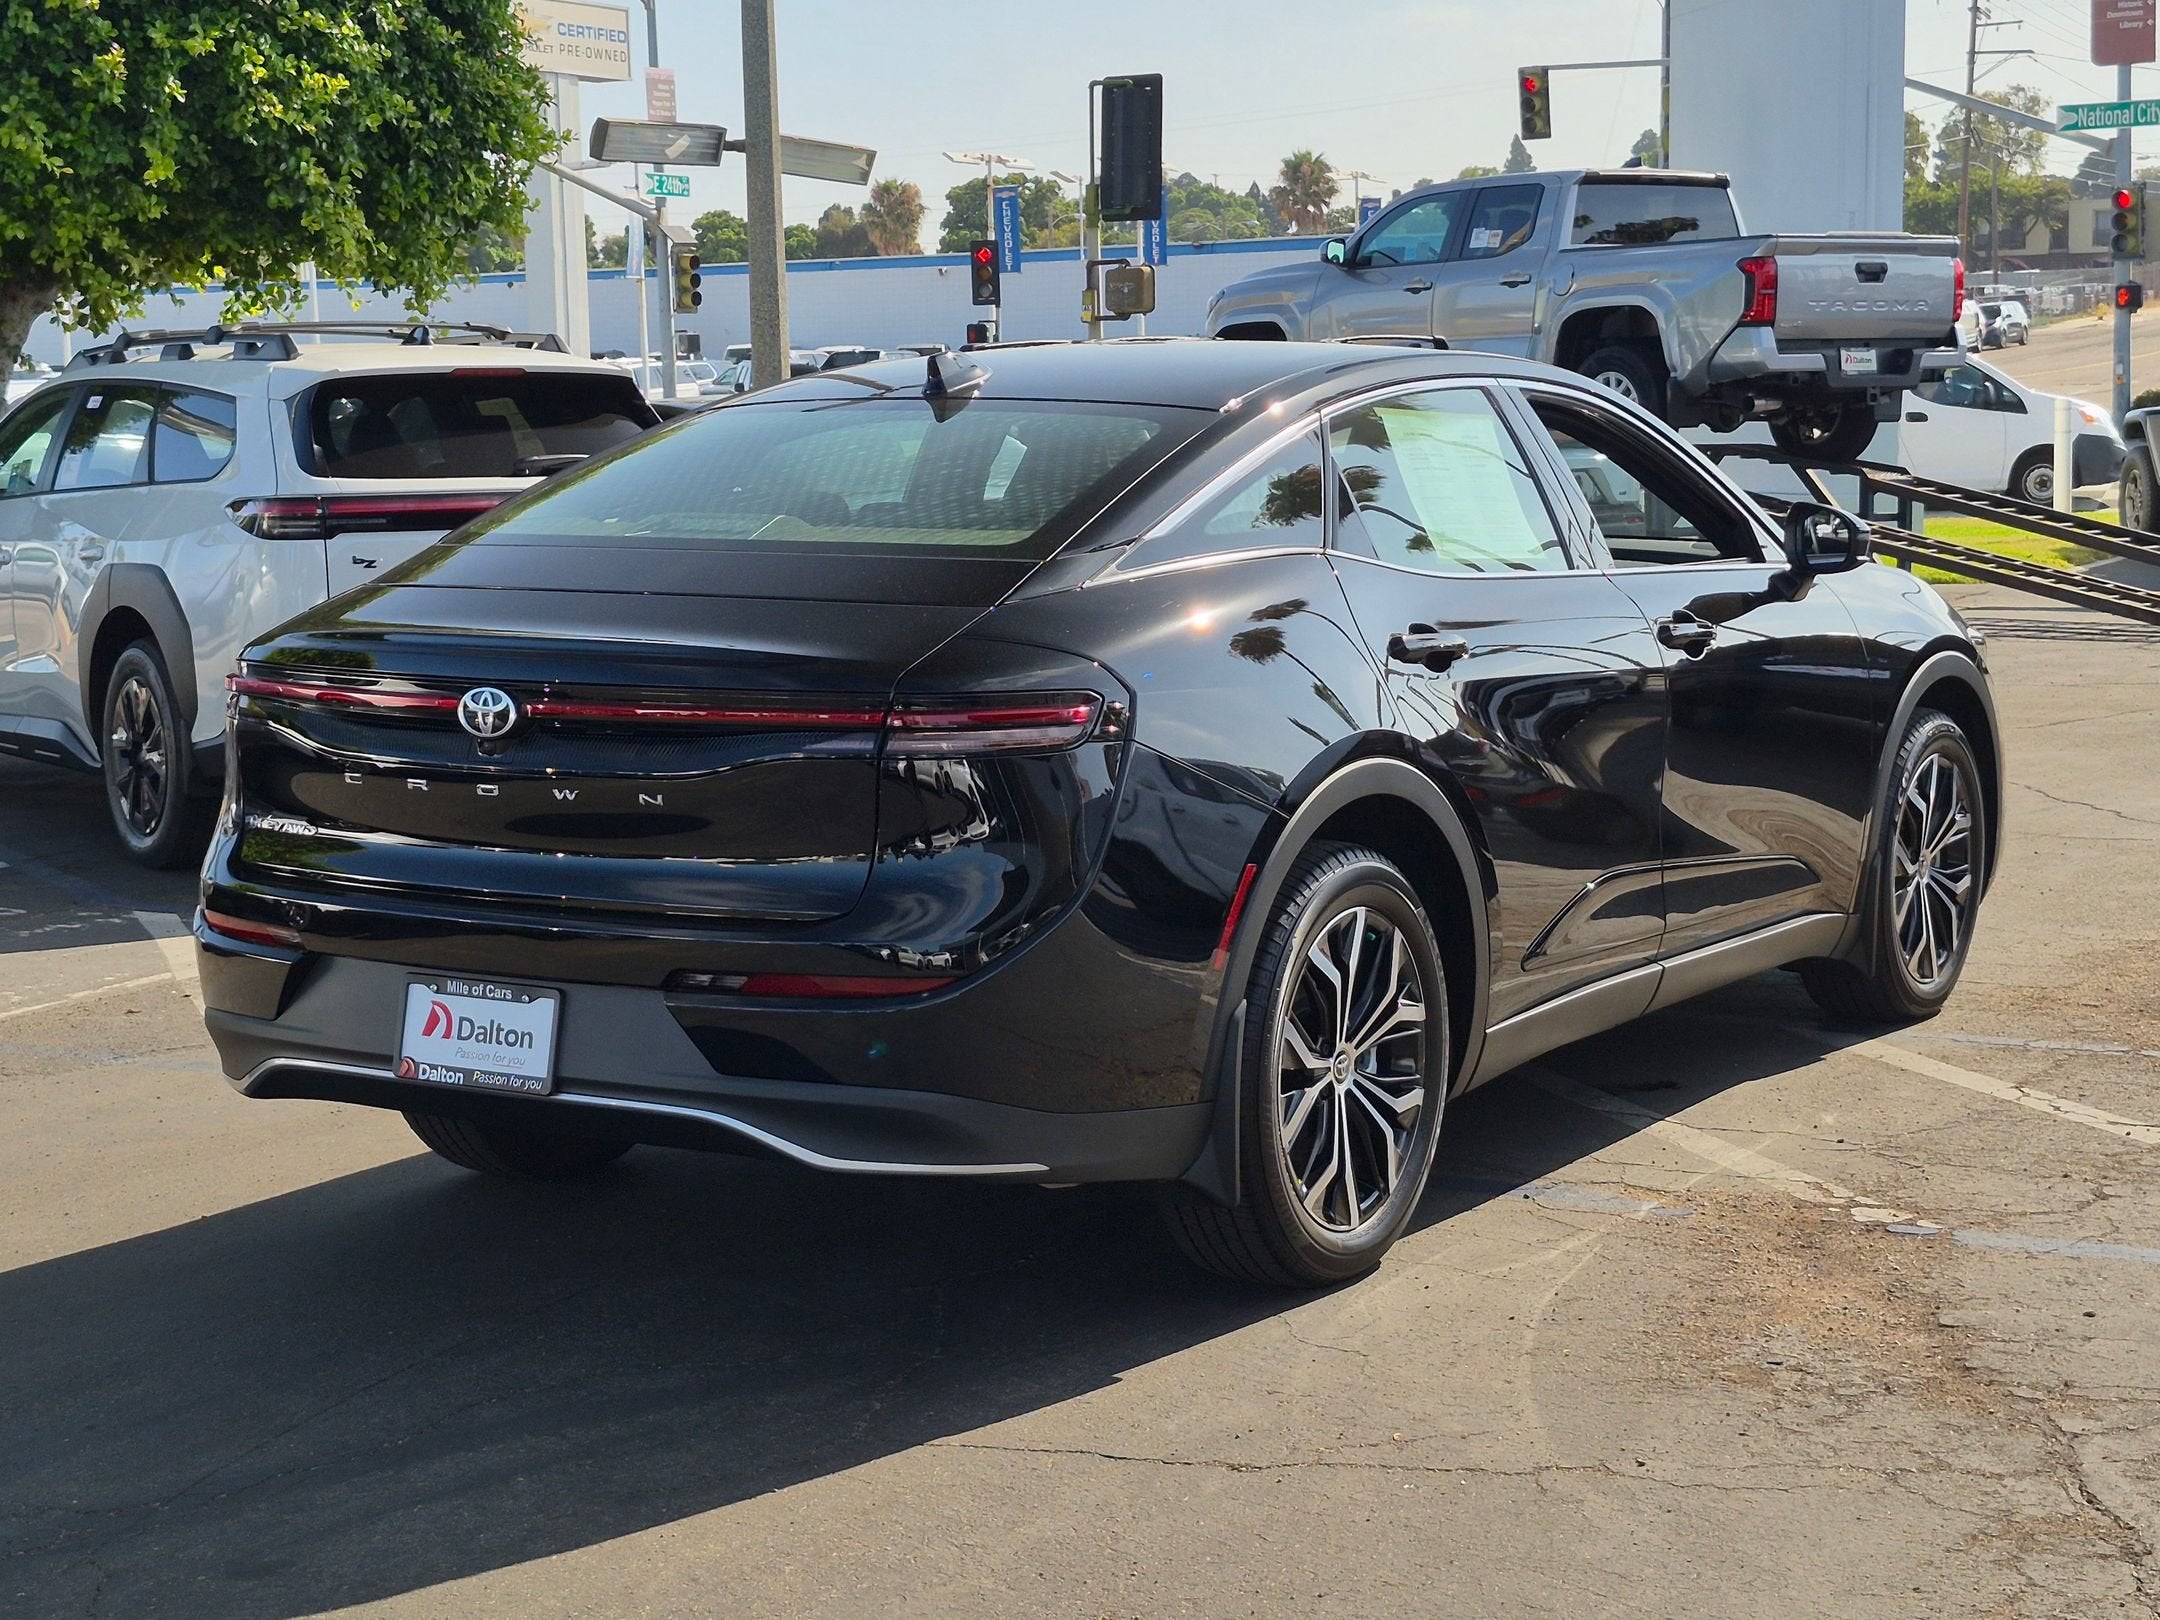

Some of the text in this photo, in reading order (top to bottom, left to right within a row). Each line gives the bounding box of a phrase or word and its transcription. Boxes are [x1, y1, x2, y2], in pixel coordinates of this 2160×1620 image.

[557, 22, 627, 44] CERTIFIED
[559, 43, 627, 62] PRE-OWNED
[2078, 104, 2135, 128] National
[654, 175, 661, 192] E
[662, 176, 682, 194] 24th
[1002, 201, 1013, 271] CHEVROLET
[1151, 220, 1160, 264] VROLET
[1808, 299, 1929, 312] TACOMA
[344, 771, 664, 806] CROWN
[447, 980, 513, 999] Mile of Cars
[456, 1015, 534, 1049] Dalton
[455, 1047, 526, 1066] Passion for you
[418, 1064, 543, 1091] Dalton Passion for you
